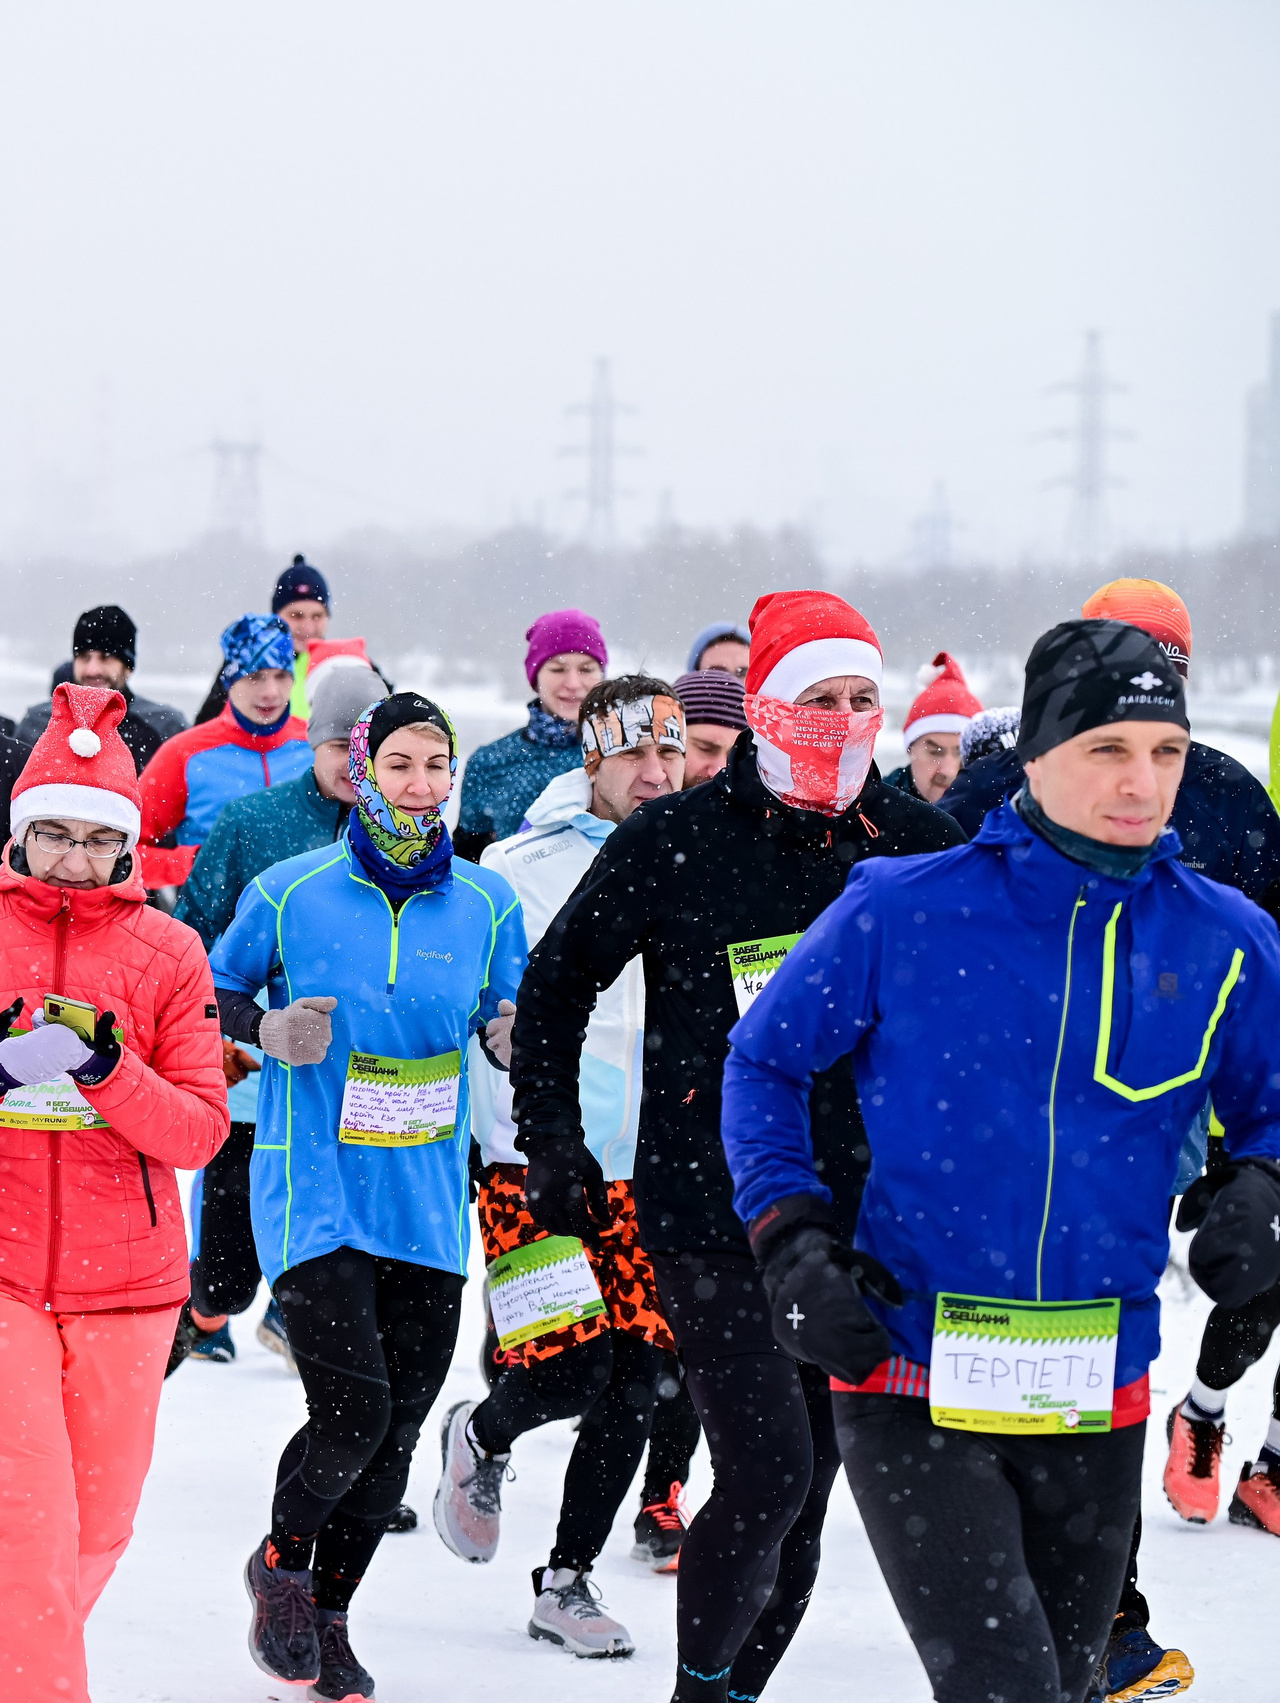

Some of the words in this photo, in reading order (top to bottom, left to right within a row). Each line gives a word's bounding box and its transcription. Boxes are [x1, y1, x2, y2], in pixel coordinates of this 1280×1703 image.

[732, 944, 762, 956] ЗАБЕГ
[734, 946, 788, 965] ОБЕЩАНИЙ
[352, 1054, 379, 1065] ЗАБЕГ
[352, 1063, 398, 1076] ОБЕЩАНИЙ
[942, 1310, 1010, 1325] ОБЕЩАНИЙ
[945, 1353, 1103, 1389] ТЕРПЕТЬ
